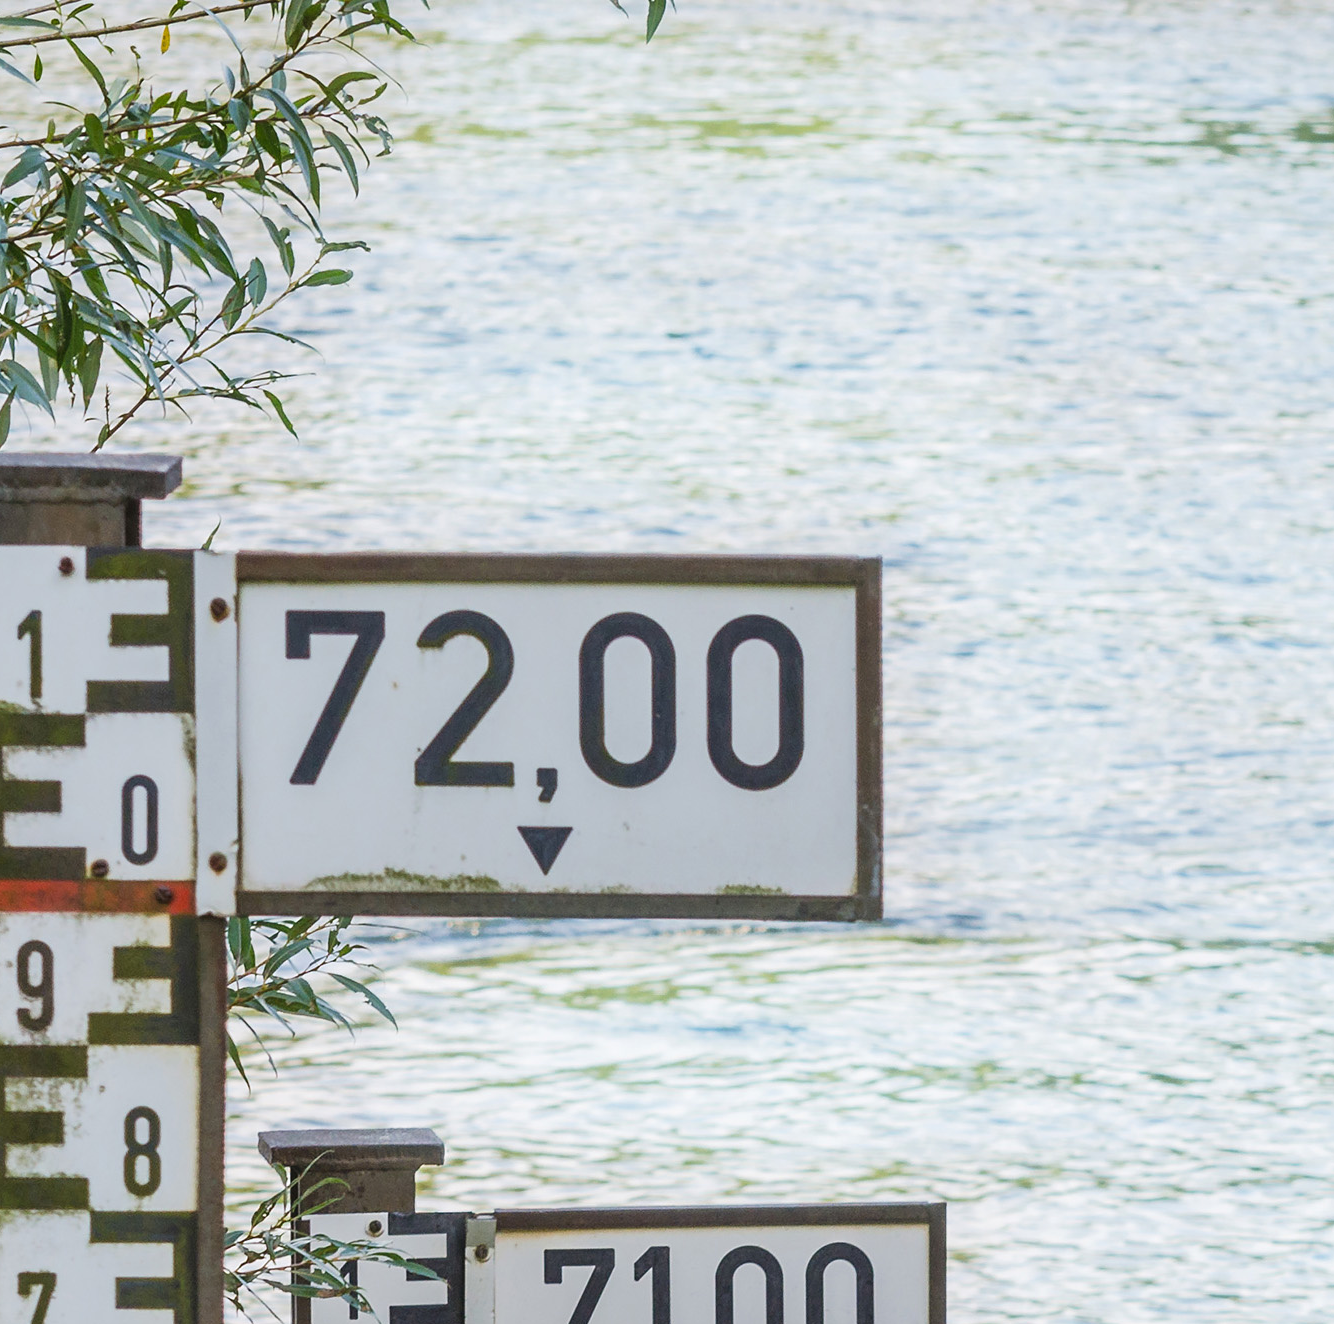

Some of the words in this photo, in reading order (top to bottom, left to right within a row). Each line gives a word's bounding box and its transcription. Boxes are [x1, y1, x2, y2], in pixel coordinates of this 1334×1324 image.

[17, 610, 43, 699] 1
[284, 609, 805, 803] 72,00
[121, 774, 159, 865] 0
[17, 940, 54, 1031] 9
[123, 1106, 162, 1196] 8
